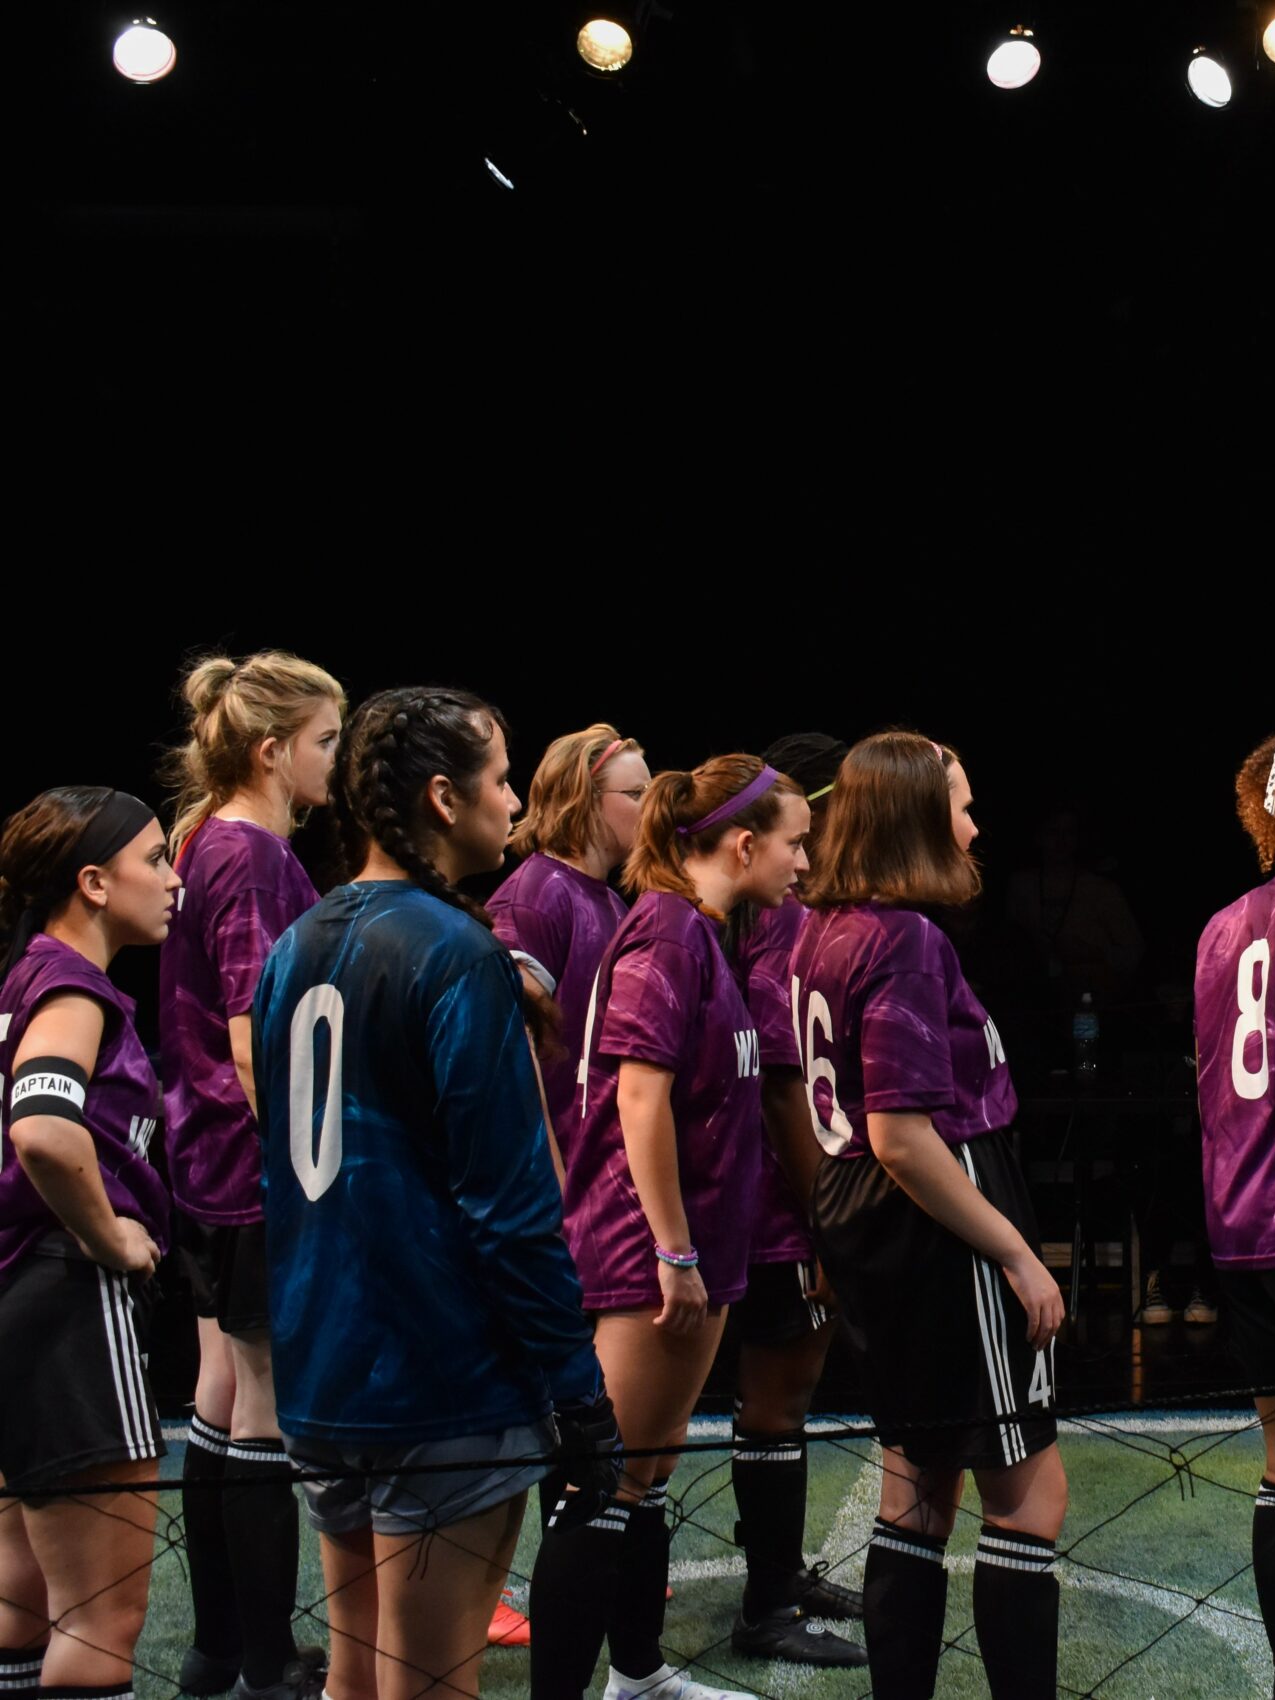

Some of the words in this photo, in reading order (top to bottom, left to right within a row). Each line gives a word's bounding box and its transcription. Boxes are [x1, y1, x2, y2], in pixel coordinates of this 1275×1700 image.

[15, 1076, 72, 1099] CAPTAIN
[289, 983, 344, 1202] 0
[1231, 938, 1270, 1099] 8
